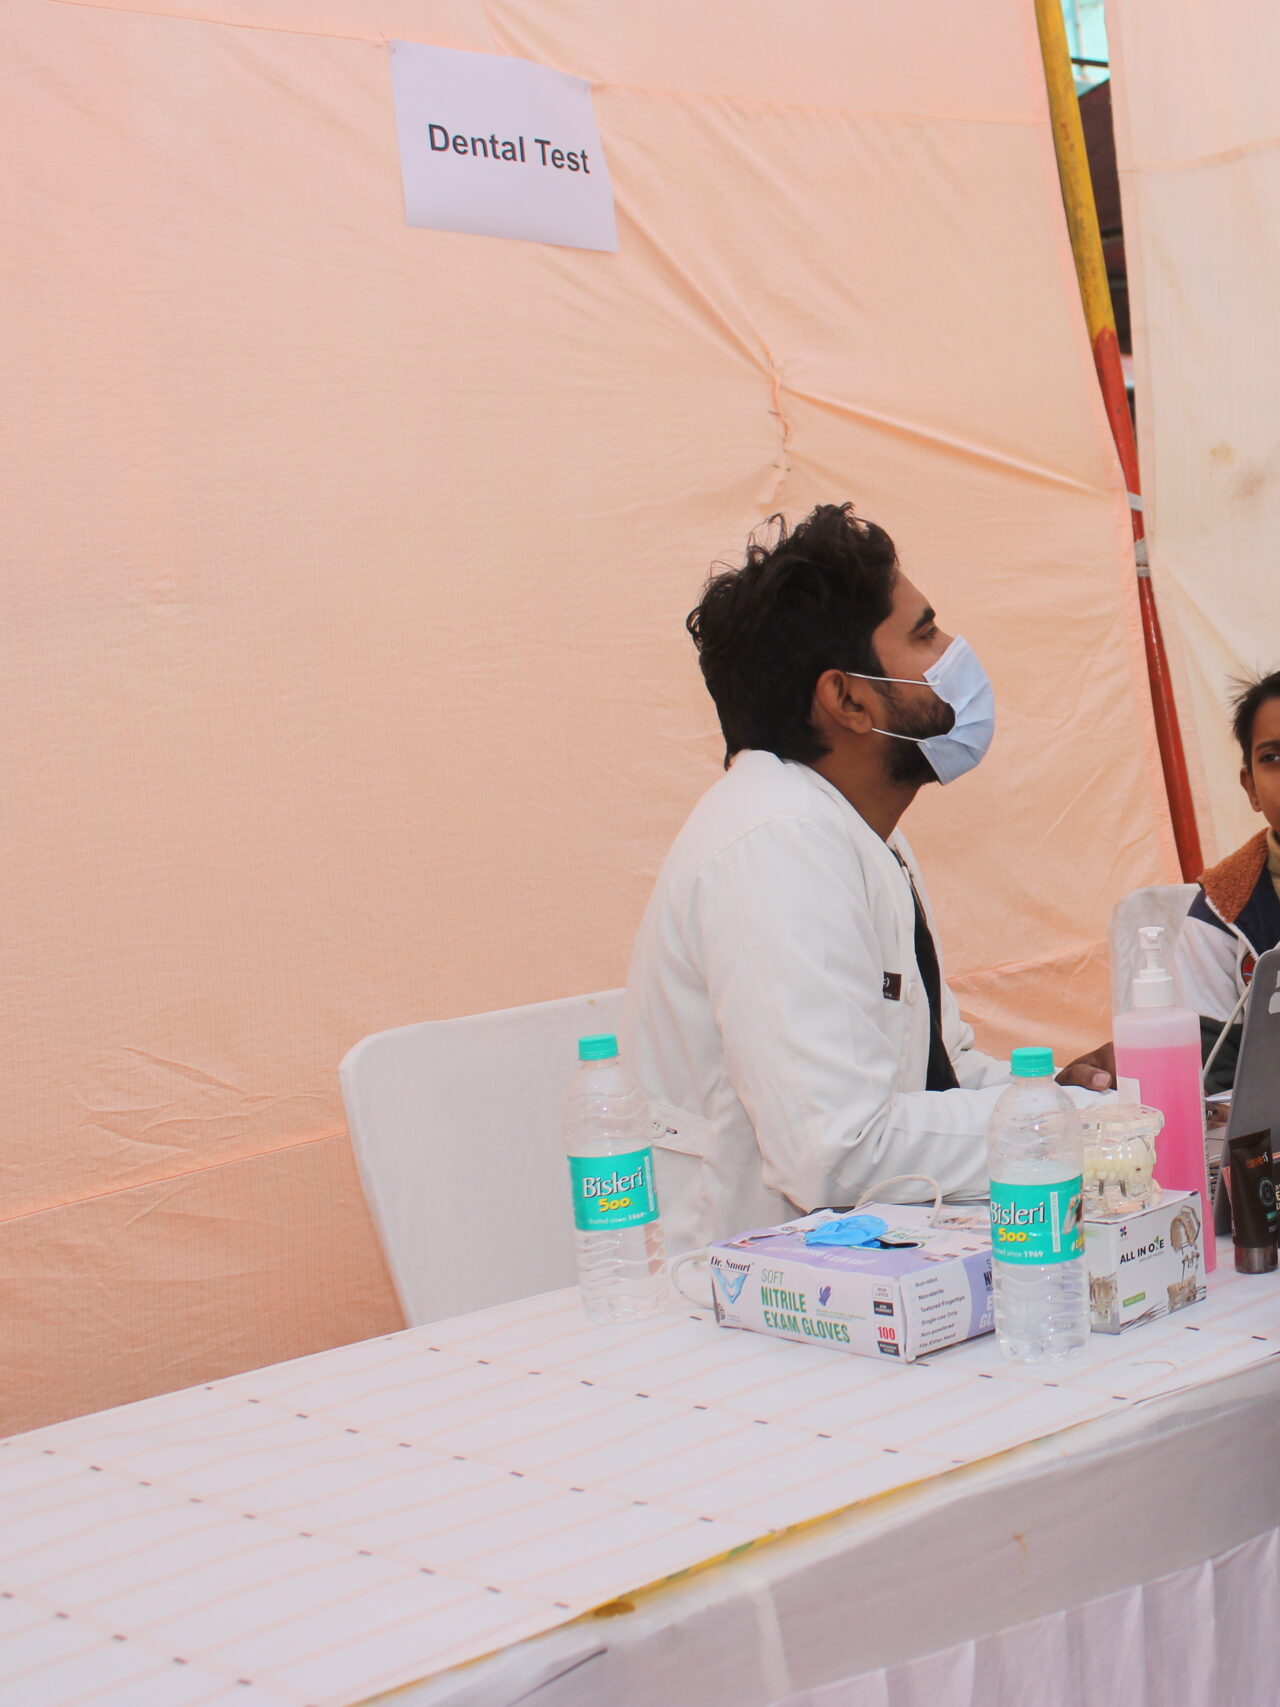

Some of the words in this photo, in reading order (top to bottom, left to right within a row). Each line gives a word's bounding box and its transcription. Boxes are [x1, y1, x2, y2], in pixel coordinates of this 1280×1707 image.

[428, 123, 526, 163] Dental
[534, 138, 591, 175] Test
[583, 1166, 644, 1198] Bisleri
[598, 1197, 631, 1213] 500
[990, 1201, 1045, 1226] Bisleri
[998, 1227, 1027, 1243] 500
[710, 1255, 723, 1268] Dr.
[1119, 1251, 1136, 1265] ALL
[1137, 1246, 1147, 1258] IN
[761, 1267, 785, 1286] SOFT
[760, 1285, 807, 1314] NITRILE
[763, 1310, 800, 1335] EXAM
[801, 1317, 851, 1344] GLOVES
[877, 1326, 896, 1341] 100
